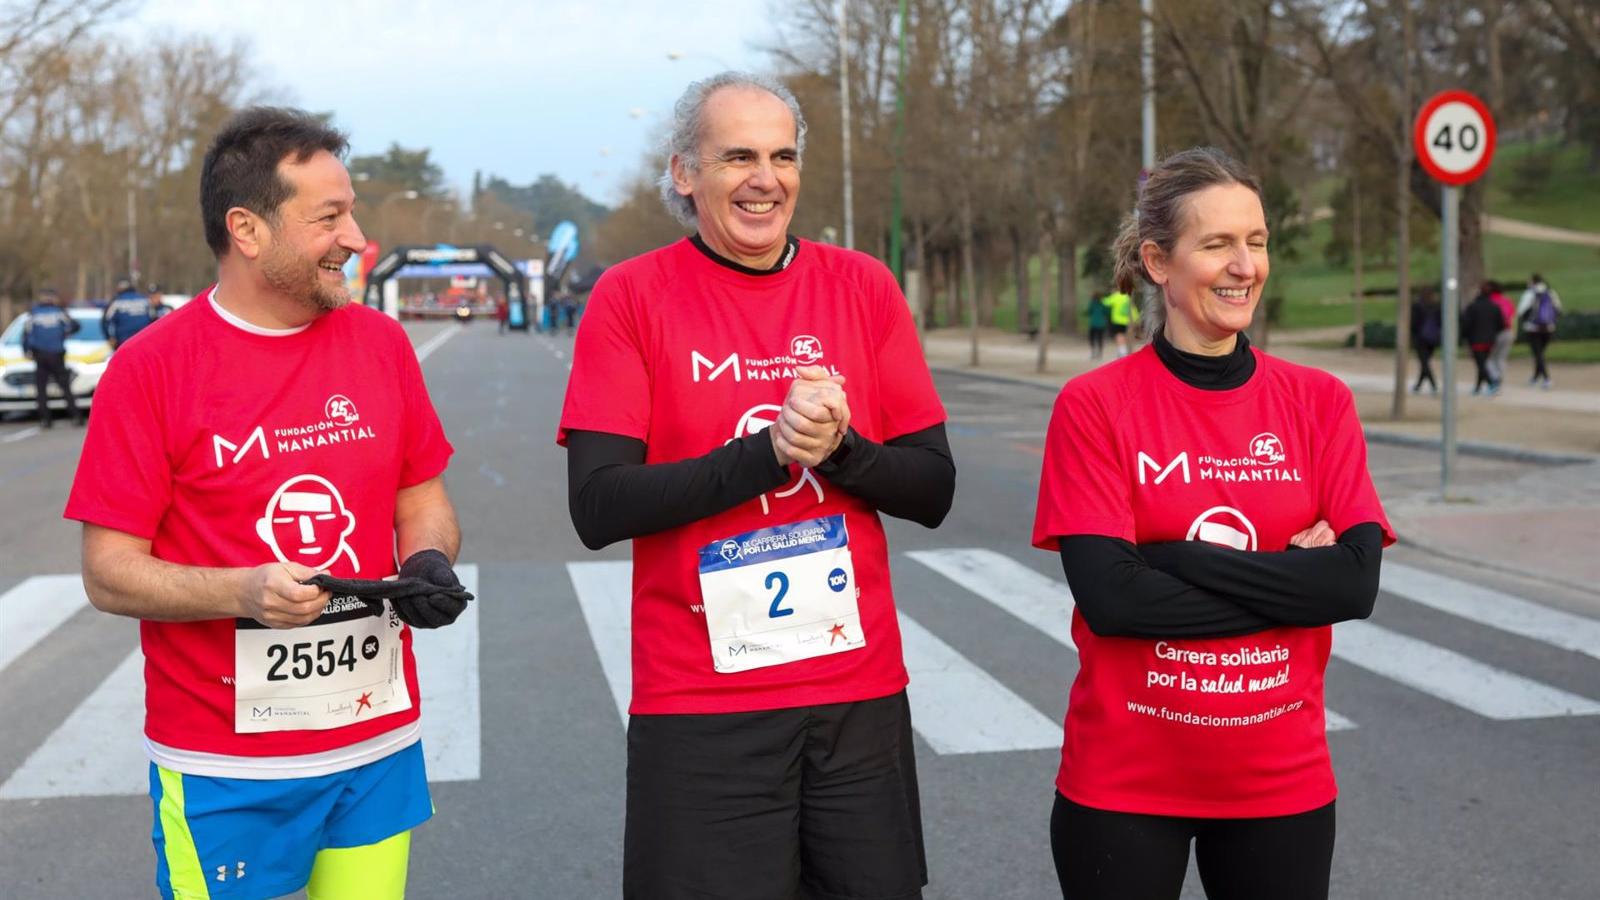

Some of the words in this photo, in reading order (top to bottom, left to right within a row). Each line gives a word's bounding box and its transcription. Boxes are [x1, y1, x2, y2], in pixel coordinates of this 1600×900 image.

[1433, 124, 1479, 152] 40
[745, 355, 798, 368] FUNDACIÓN
[331, 401, 349, 418] 25
[274, 420, 334, 438] FUNDACIÓN
[277, 425, 376, 453] MANANTIAL
[1255, 439, 1277, 457] 25
[1198, 456, 1258, 468] FUNDACIÓN
[1200, 467, 1302, 483] MANANTIAL
[744, 545, 760, 555] POR
[762, 544, 772, 552] LA
[773, 538, 798, 550] SALUD
[799, 534, 827, 544] MENTAL
[830, 573, 846, 586] 10K
[765, 571, 794, 618] 2
[321, 604, 341, 614] ALUD
[342, 601, 368, 612] MENTAL
[267, 635, 357, 682] 2554
[1155, 641, 1217, 666] Carrera
[1220, 645, 1289, 666] solidaria
[1147, 670, 1177, 688] por
[1181, 672, 1197, 691] la
[1200, 674, 1245, 693] salud
[1248, 664, 1290, 692] mental
[1127, 700, 1303, 727] www.fundacionmanantial.org
